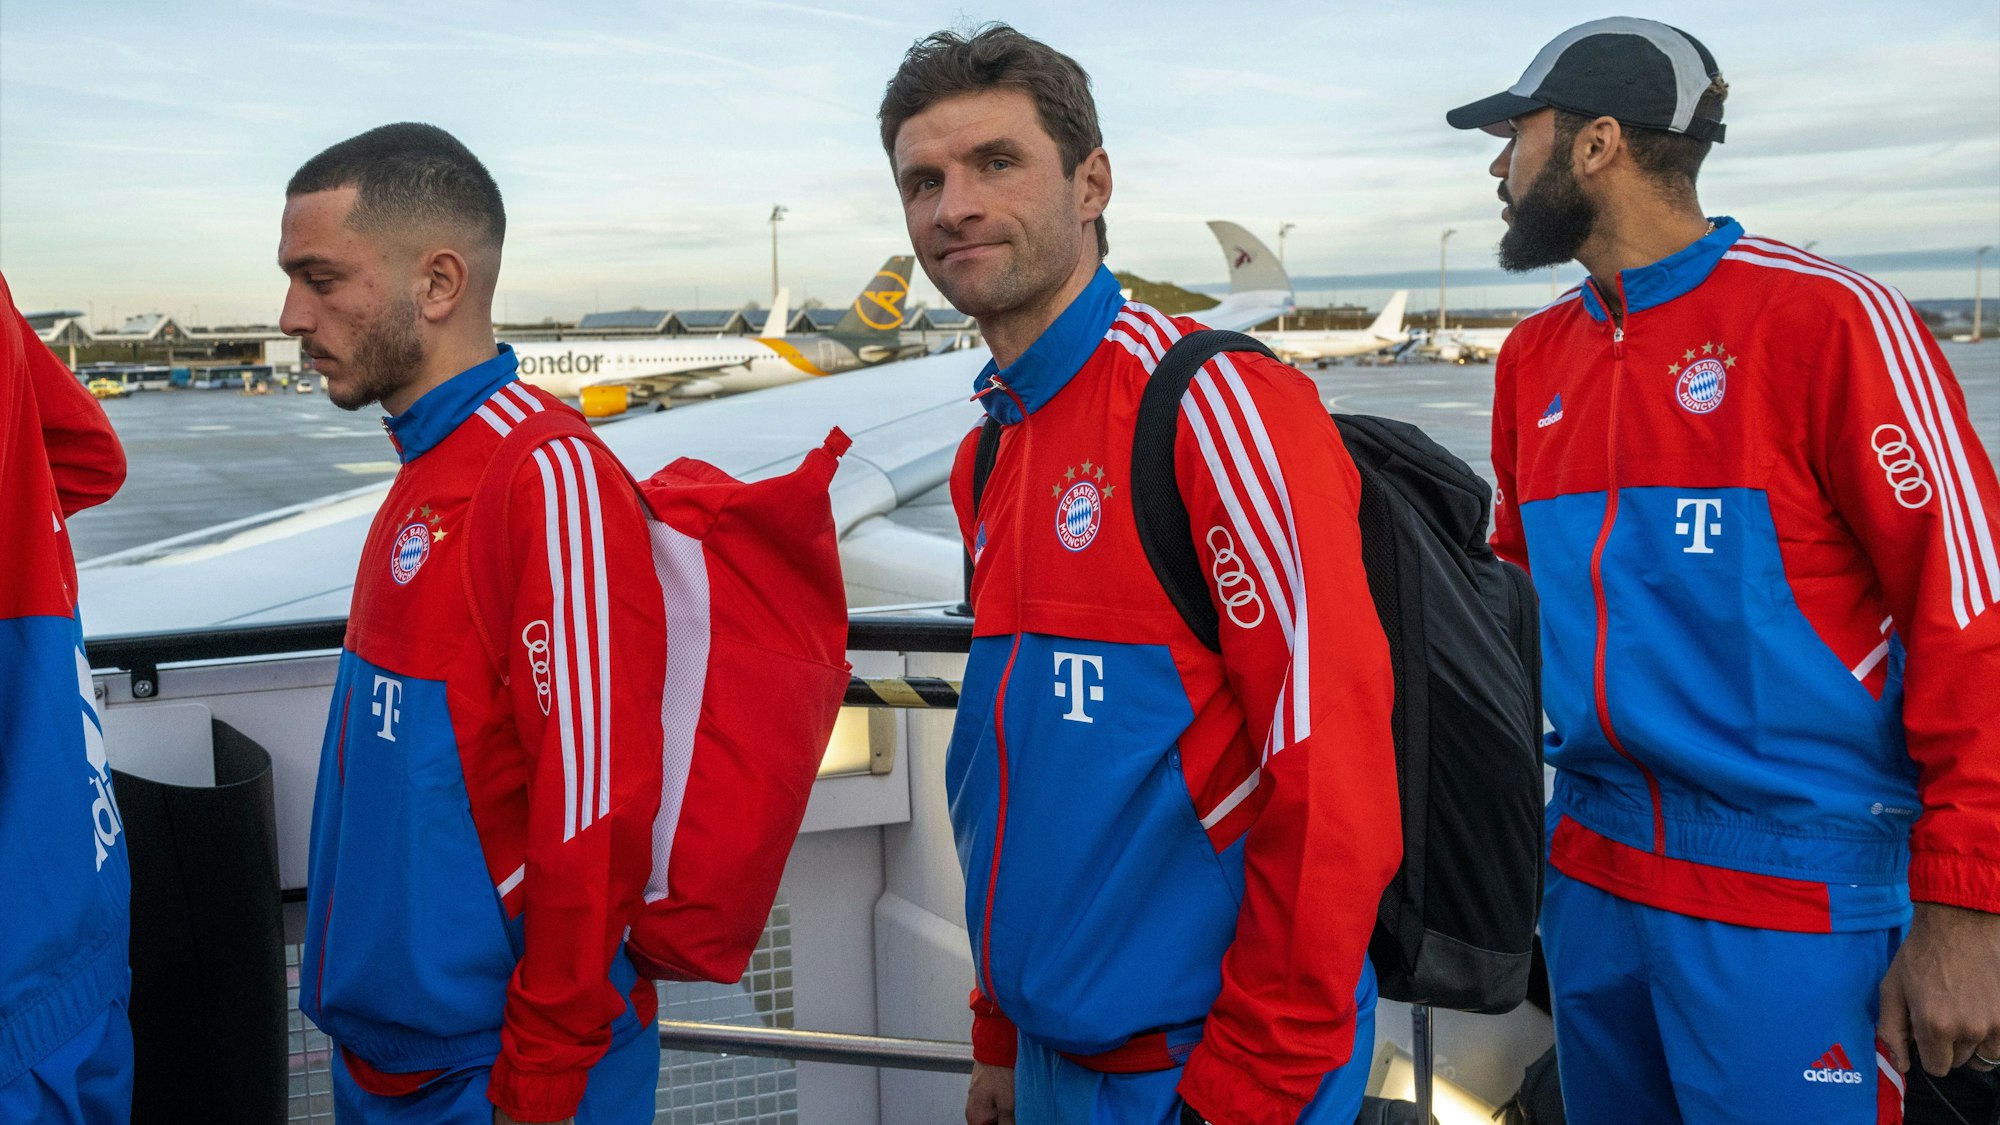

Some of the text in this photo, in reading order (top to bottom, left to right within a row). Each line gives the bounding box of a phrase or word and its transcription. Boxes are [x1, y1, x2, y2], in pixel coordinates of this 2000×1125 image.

[515, 350, 604, 375] ondor
[1682, 362, 1724, 385] FC BAYERN
[1537, 410, 1564, 428] adidas
[1062, 486, 1099, 512] FC BAYERN
[1675, 498, 1722, 554] T
[398, 527, 428, 551] FC BAYERN
[1053, 651, 1104, 724] T
[372, 674, 402, 743] T
[1803, 1068, 1862, 1084] adidas
